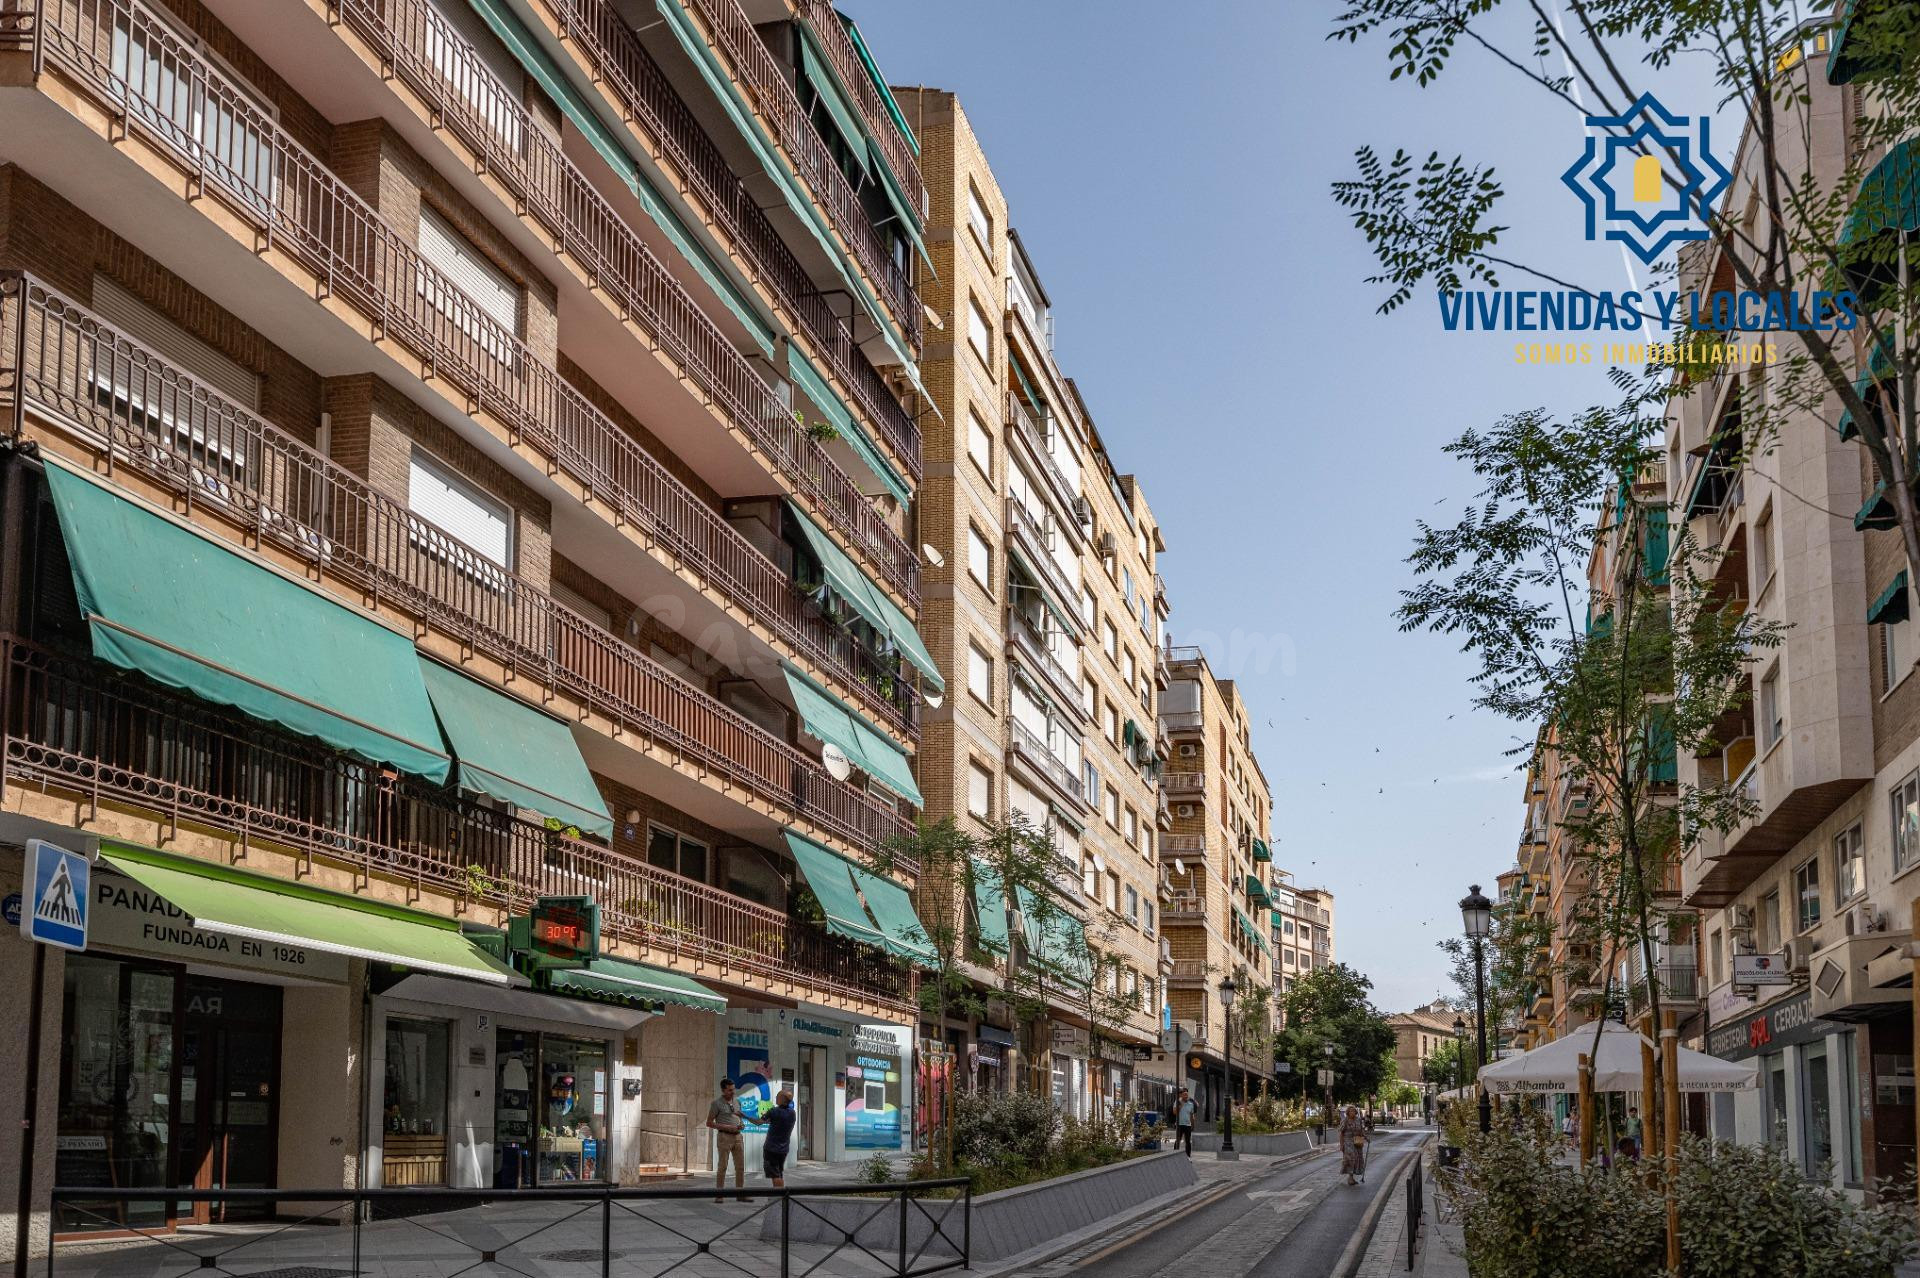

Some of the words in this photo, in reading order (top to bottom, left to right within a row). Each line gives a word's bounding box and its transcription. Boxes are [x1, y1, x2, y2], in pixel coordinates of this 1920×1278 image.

[144, 923, 230, 952] FUNDADA
[241, 941, 263, 958] EN
[272, 947, 306, 965] 1926
[728, 1032, 769, 1047] SMILE
[857, 1056, 891, 1069] ORTODONCIA
[1513, 1080, 1565, 1091] Alhambra
